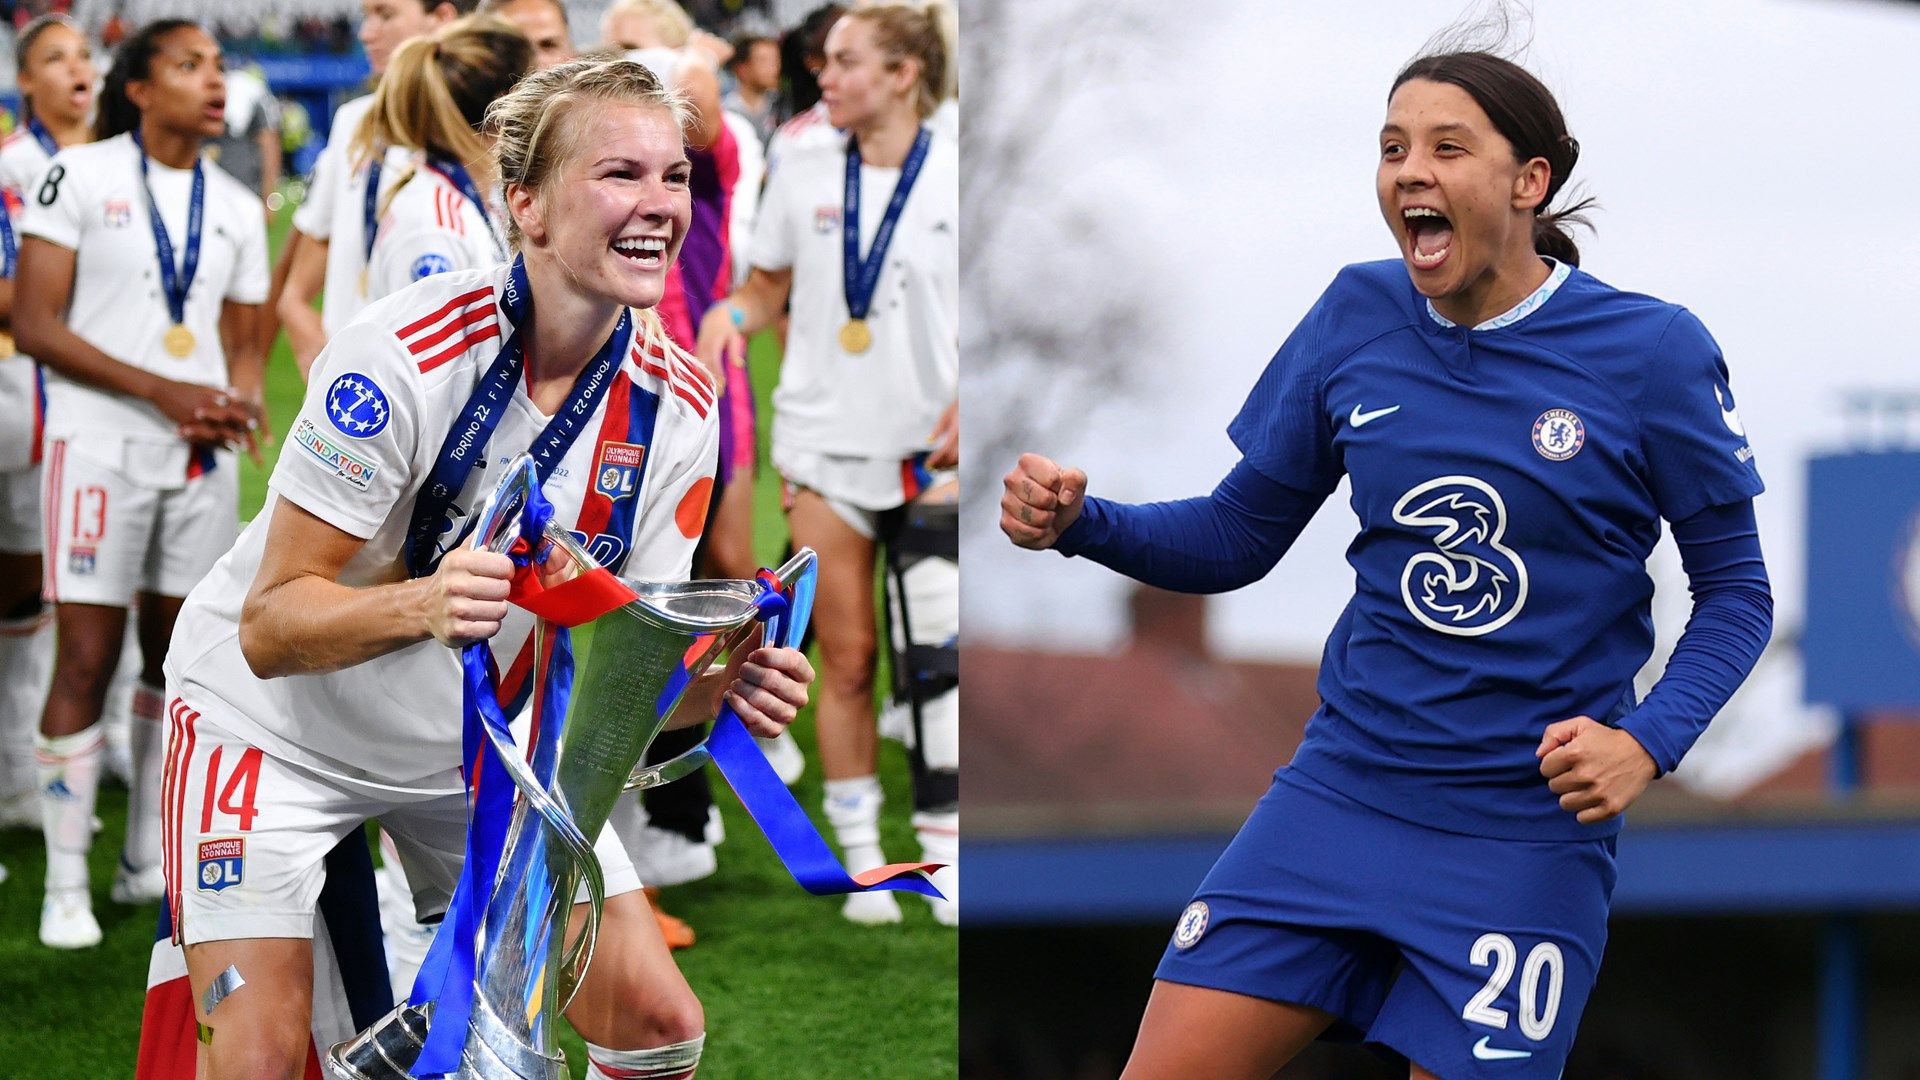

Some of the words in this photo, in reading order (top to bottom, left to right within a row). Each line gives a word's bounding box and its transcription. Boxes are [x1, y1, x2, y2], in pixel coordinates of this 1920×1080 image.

[38, 164, 66, 207] 8
[474, 405, 491, 422] 22
[488, 349, 522, 400] FINAL
[347, 390, 369, 412] 7
[573, 398, 588, 415] 22
[1544, 411, 1578, 425] CHELSEA
[534, 418, 573, 468] FINAL
[606, 446, 641, 458] OLYMPIQUE
[605, 454, 640, 464] LYONNAIS
[72, 485, 107, 542] 13
[200, 745, 264, 834] 14
[201, 841, 241, 852] OLYMPIQUE
[201, 848, 241, 858] LYONNAIS
[1462, 932, 1565, 1042] 20
